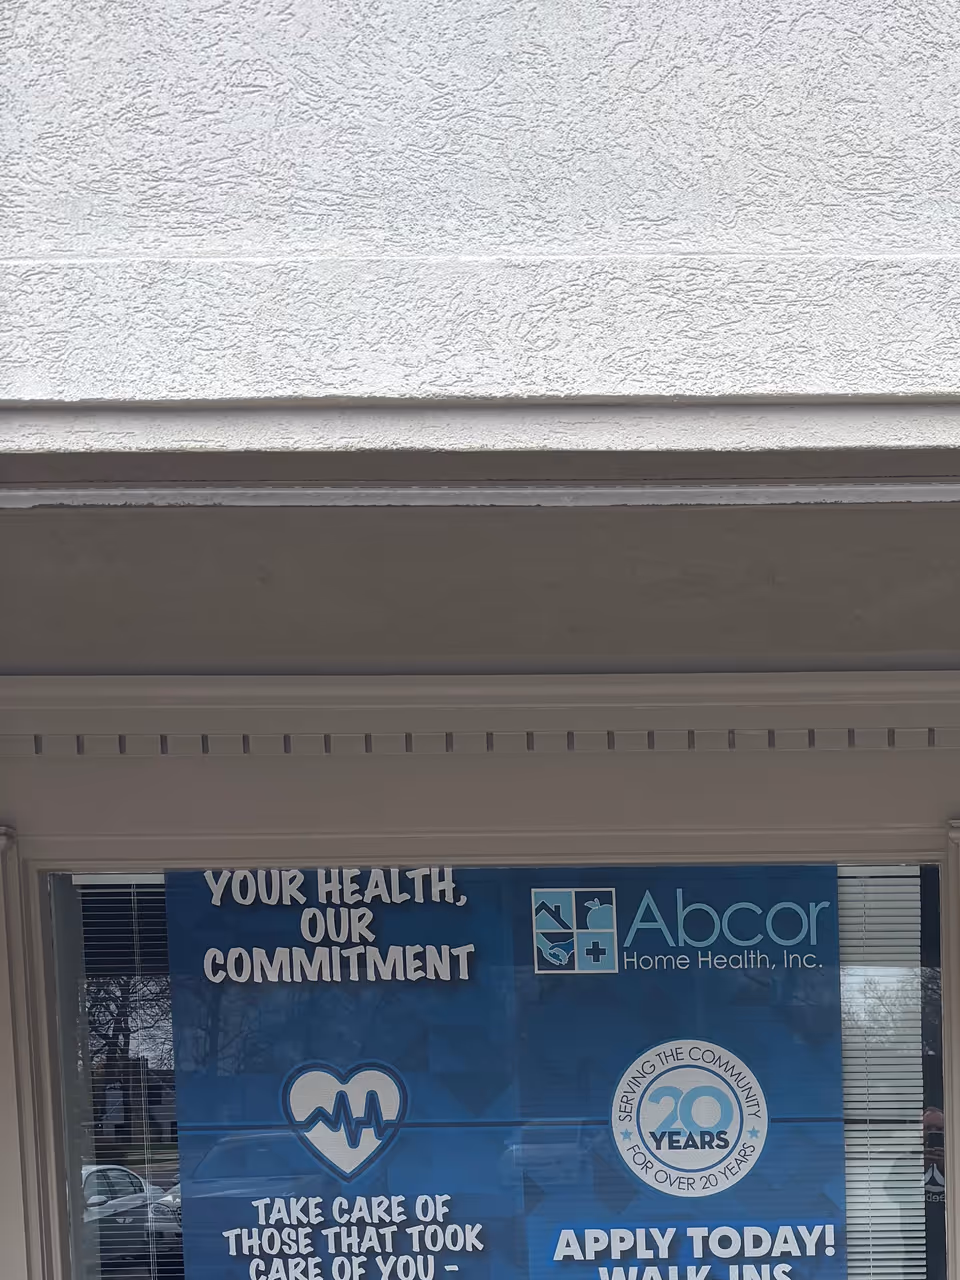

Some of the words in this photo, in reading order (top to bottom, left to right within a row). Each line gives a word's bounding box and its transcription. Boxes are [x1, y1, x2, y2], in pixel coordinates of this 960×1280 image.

[204, 869, 306, 906] YOUR
[317, 867, 467, 906] HEALTH,
[301, 907, 376, 943] OUR
[623, 888, 831, 948] Abcor
[204, 944, 475, 983] COMMITMENT
[624, 951, 690, 970] Home
[698, 950, 776, 970] Health,
[783, 950, 823, 969] Inc.
[618, 1060, 656, 1122] SERVING
[655, 1047, 685, 1066] THE
[688, 1046, 762, 1119] COMMUNITY
[648, 1085, 734, 1137] 20
[649, 1130, 730, 1150] YEARS
[626, 1144, 654, 1175] FOR
[654, 1169, 696, 1191] OVER
[700, 1173, 718, 1190] 20
[718, 1142, 756, 1181] YEARS
[251, 1196, 324, 1225] TAKE
[332, 1195, 407, 1225] CARE
[415, 1194, 451, 1223] OF
[222, 1226, 314, 1256] THOSE
[321, 1225, 398, 1254] THAT
[405, 1223, 485, 1252] TOOK
[553, 1227, 677, 1261] APPLY
[686, 1224, 836, 1259] TODAY!
